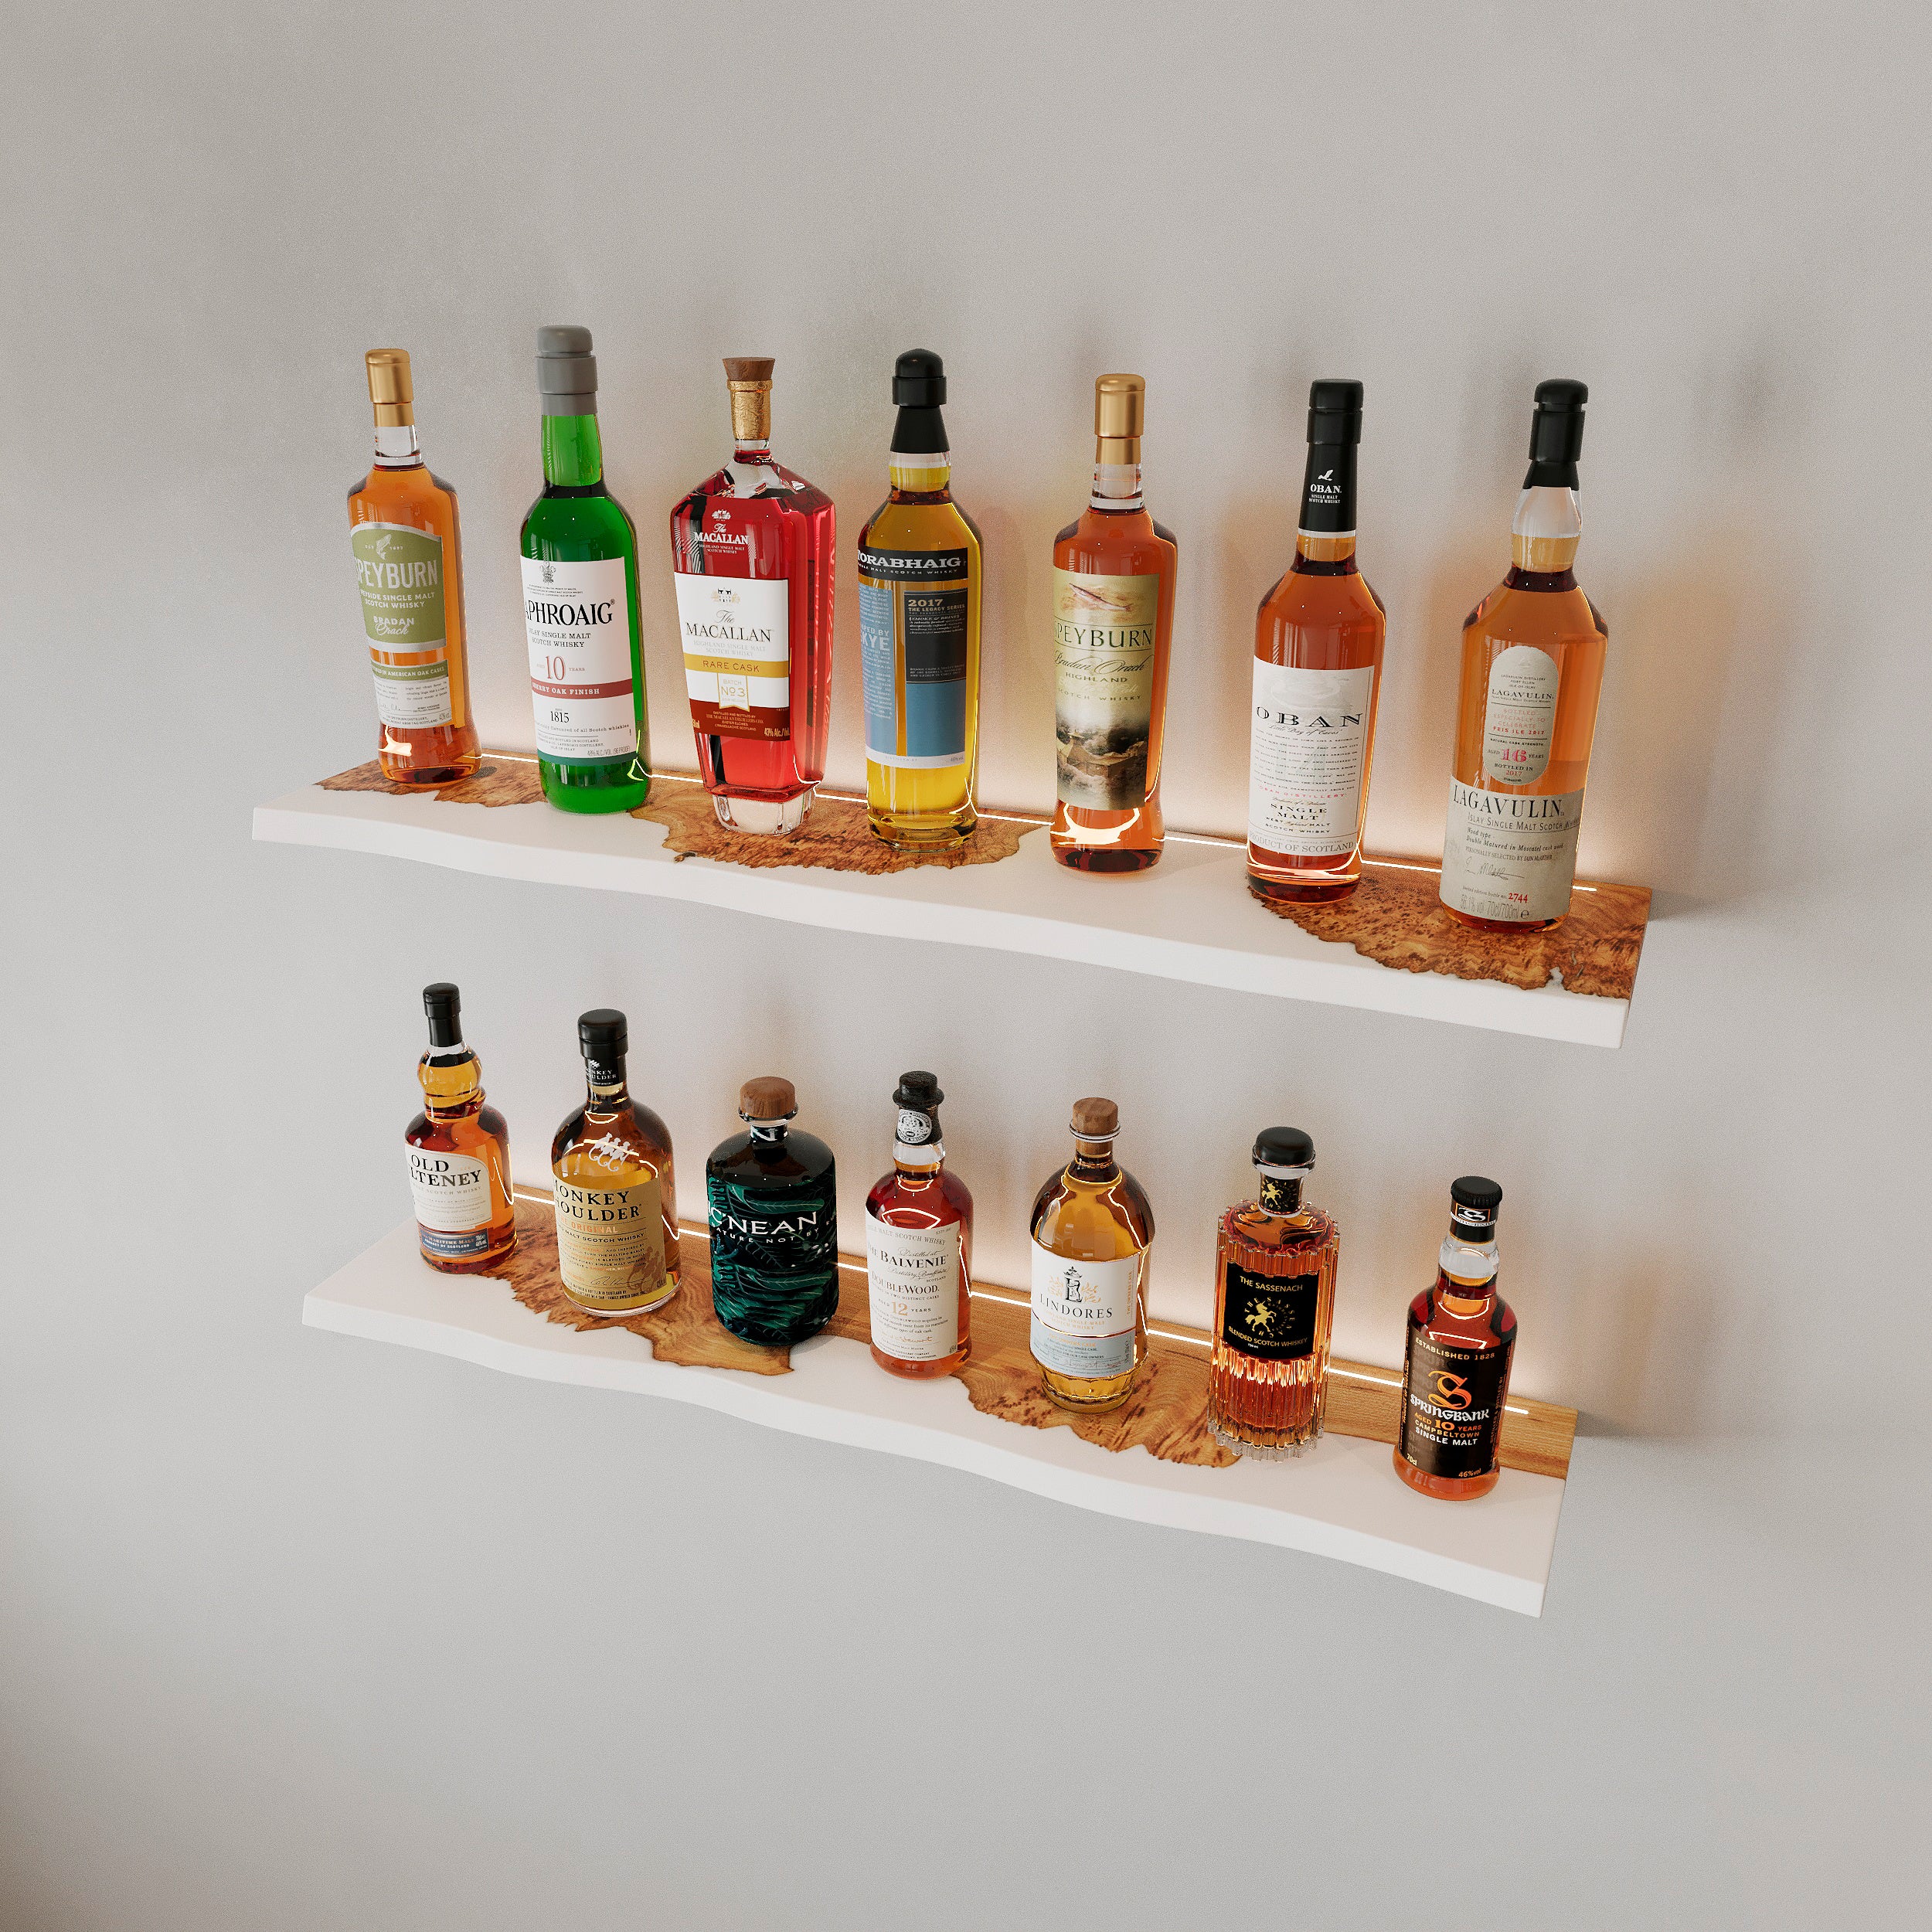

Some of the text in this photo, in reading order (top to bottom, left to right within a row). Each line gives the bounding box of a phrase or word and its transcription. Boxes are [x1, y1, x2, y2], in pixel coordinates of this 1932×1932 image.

[1310, 484, 1342, 494] OBAN
[712, 523, 727, 533] The
[693, 532, 749, 544] MACALLAN
[365, 598, 389, 609] SCOTCH
[373, 615, 415, 625] BRADAN
[716, 610, 735, 624] The
[542, 631, 566, 639] SINGLE
[685, 622, 772, 643] MACALLAN
[861, 631, 890, 651] KYE
[545, 655, 566, 681] 10
[703, 660, 760, 672] RARE CASK
[1066, 672, 1128, 682] HIGHLAND
[1492, 689, 1553, 699] LAGAVULIN
[550, 710, 570, 723] 1815
[1257, 706, 1363, 728] OBAN
[1501, 749, 1528, 763] 16
[1454, 784, 1562, 818] LAGAVULIN
[1270, 804, 1328, 813] SINGLE
[1277, 811, 1319, 821] MALT
[1468, 812, 1563, 832] ISLAY SINGLE MALT SCOTCH
[1249, 833, 1284, 849] PRODUCT
[1284, 843, 1299, 852] OF
[1301, 842, 1355, 853] SCOTLAND
[1466, 836, 1482, 845] Double
[1483, 839, 1508, 849] Matured
[1465, 846, 1491, 857] PERSONALLY
[1492, 851, 1516, 861] SELECTED
[1509, 893, 1528, 903] 2744
[411, 1155, 450, 1172] OLD
[410, 1167, 481, 1187] LTENEY
[556, 1197, 640, 1222] OULDER
[565, 1230, 580, 1239] MALT
[617, 1233, 645, 1241] WHISKY
[571, 1223, 618, 1234] ORIGINAL
[896, 1233, 922, 1242] SCOTCH
[924, 1236, 947, 1246] WHISKY
[881, 1250, 947, 1269] BALVENIE
[1240, 1275, 1303, 1292] THE SASSENACH
[892, 1301, 908, 1316] 12
[1040, 1294, 1113, 1318] LINDORES
[1228, 1325, 1308, 1347] BLENDED SCOTCH WHISKEY
[1416, 1337, 1470, 1360] ESTABLISHED
[1414, 1412, 1432, 1426] AGED
[1435, 1419, 1454, 1431] 10
[1415, 1420, 1480, 1438] CAMPBELTOWN
[1415, 1427, 1448, 1445] SINGLE
[1406, 1453, 1417, 1466] 70cl
